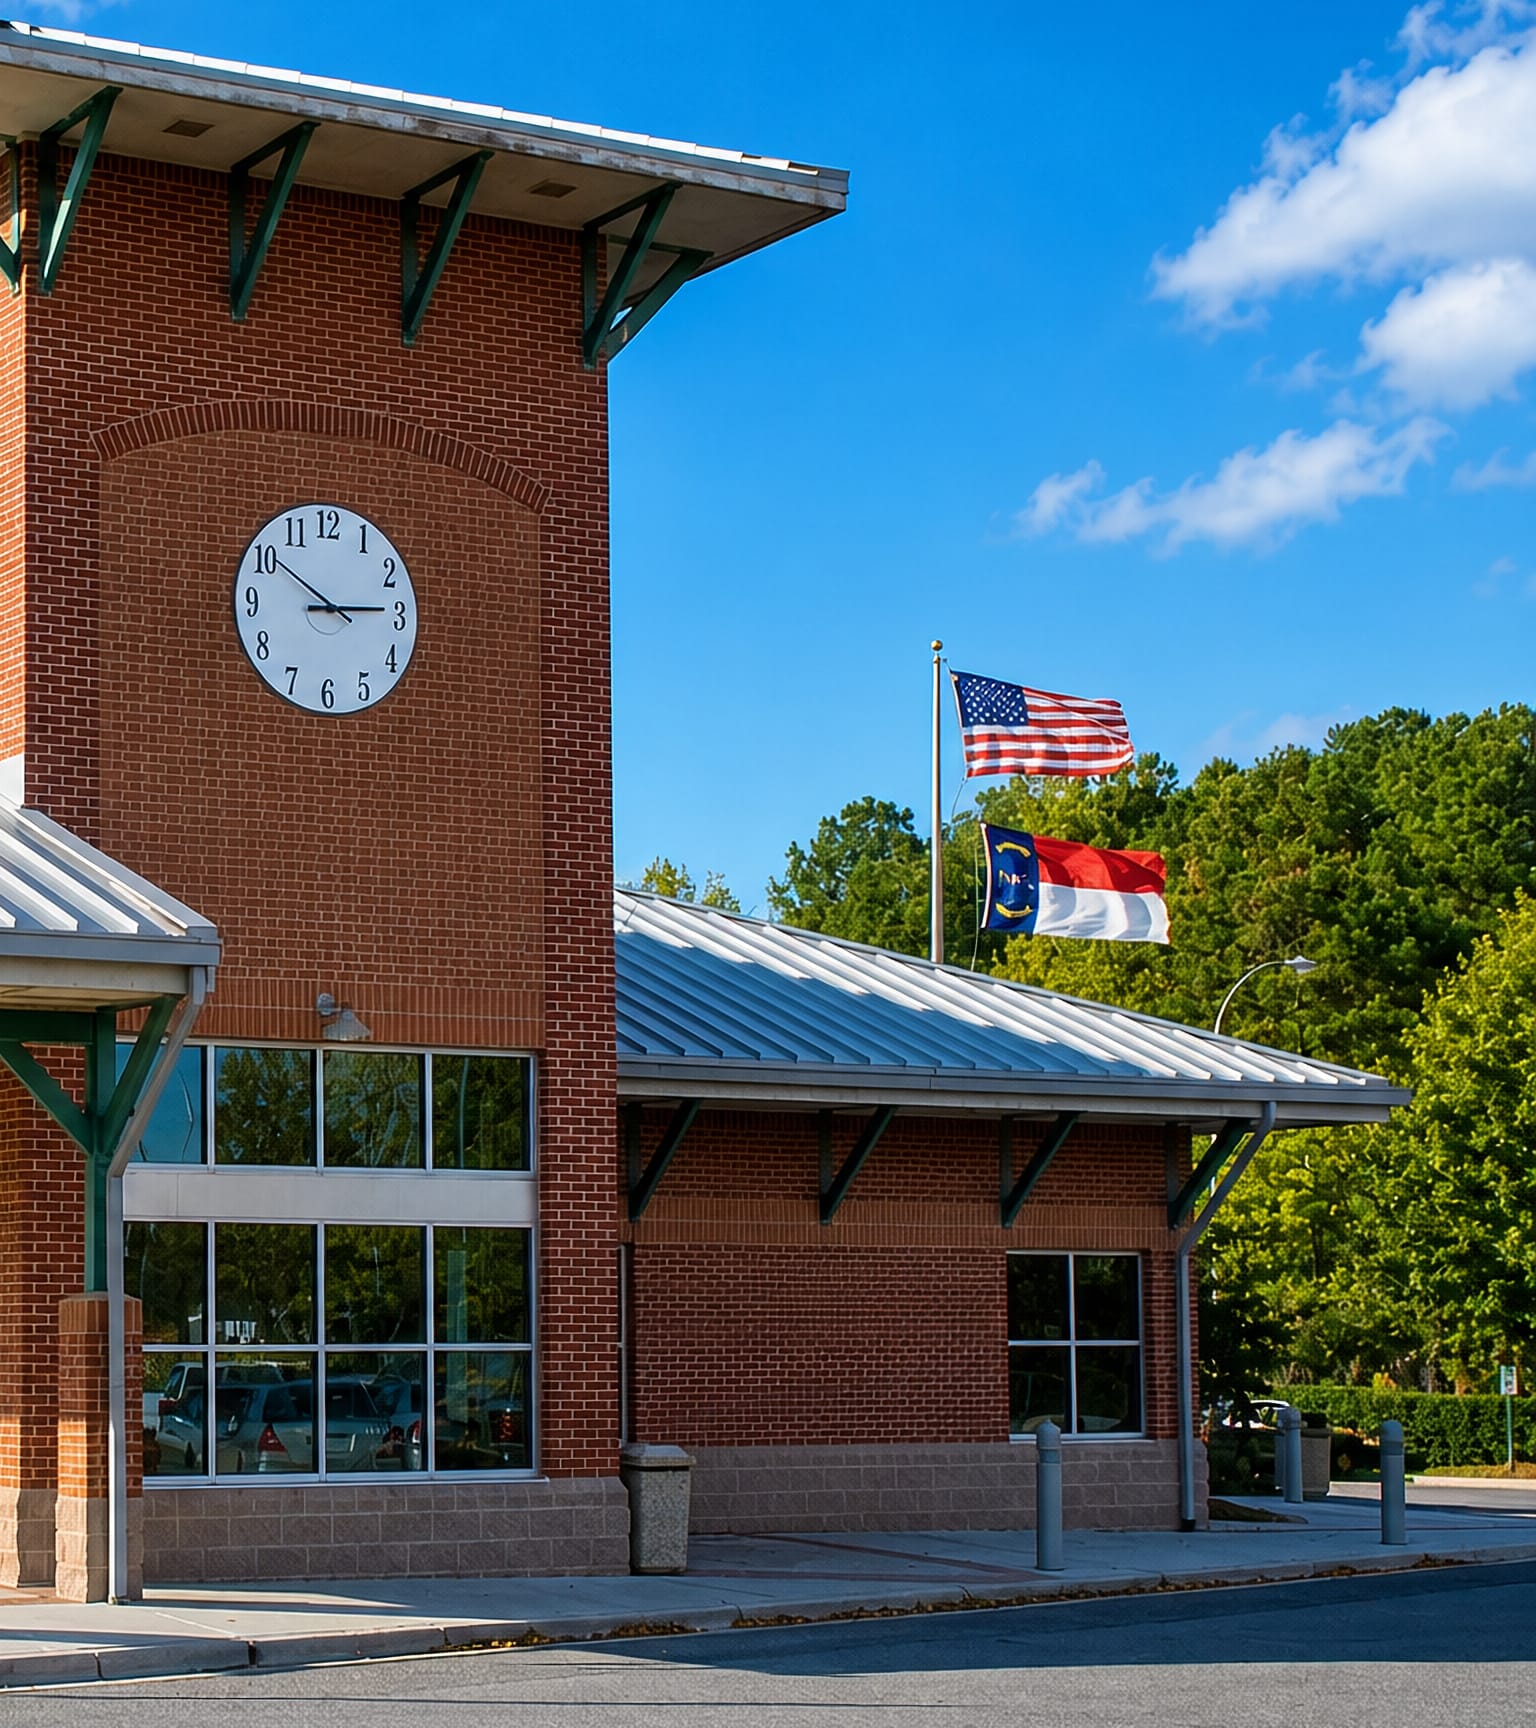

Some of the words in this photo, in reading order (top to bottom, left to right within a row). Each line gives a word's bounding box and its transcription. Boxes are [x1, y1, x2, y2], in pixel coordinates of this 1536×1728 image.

[285, 517, 307, 548] 11
[317, 510, 340, 540] 12
[359, 524, 368, 554] 1
[254, 543, 277, 574] 10
[383, 558, 396, 588] 2
[246, 587, 259, 617] 9
[393, 601, 406, 631] 3
[256, 631, 270, 660] 8
[385, 643, 397, 673] 4
[285, 667, 298, 696] 7
[321, 679, 334, 709] 6
[358, 672, 370, 701] 5
